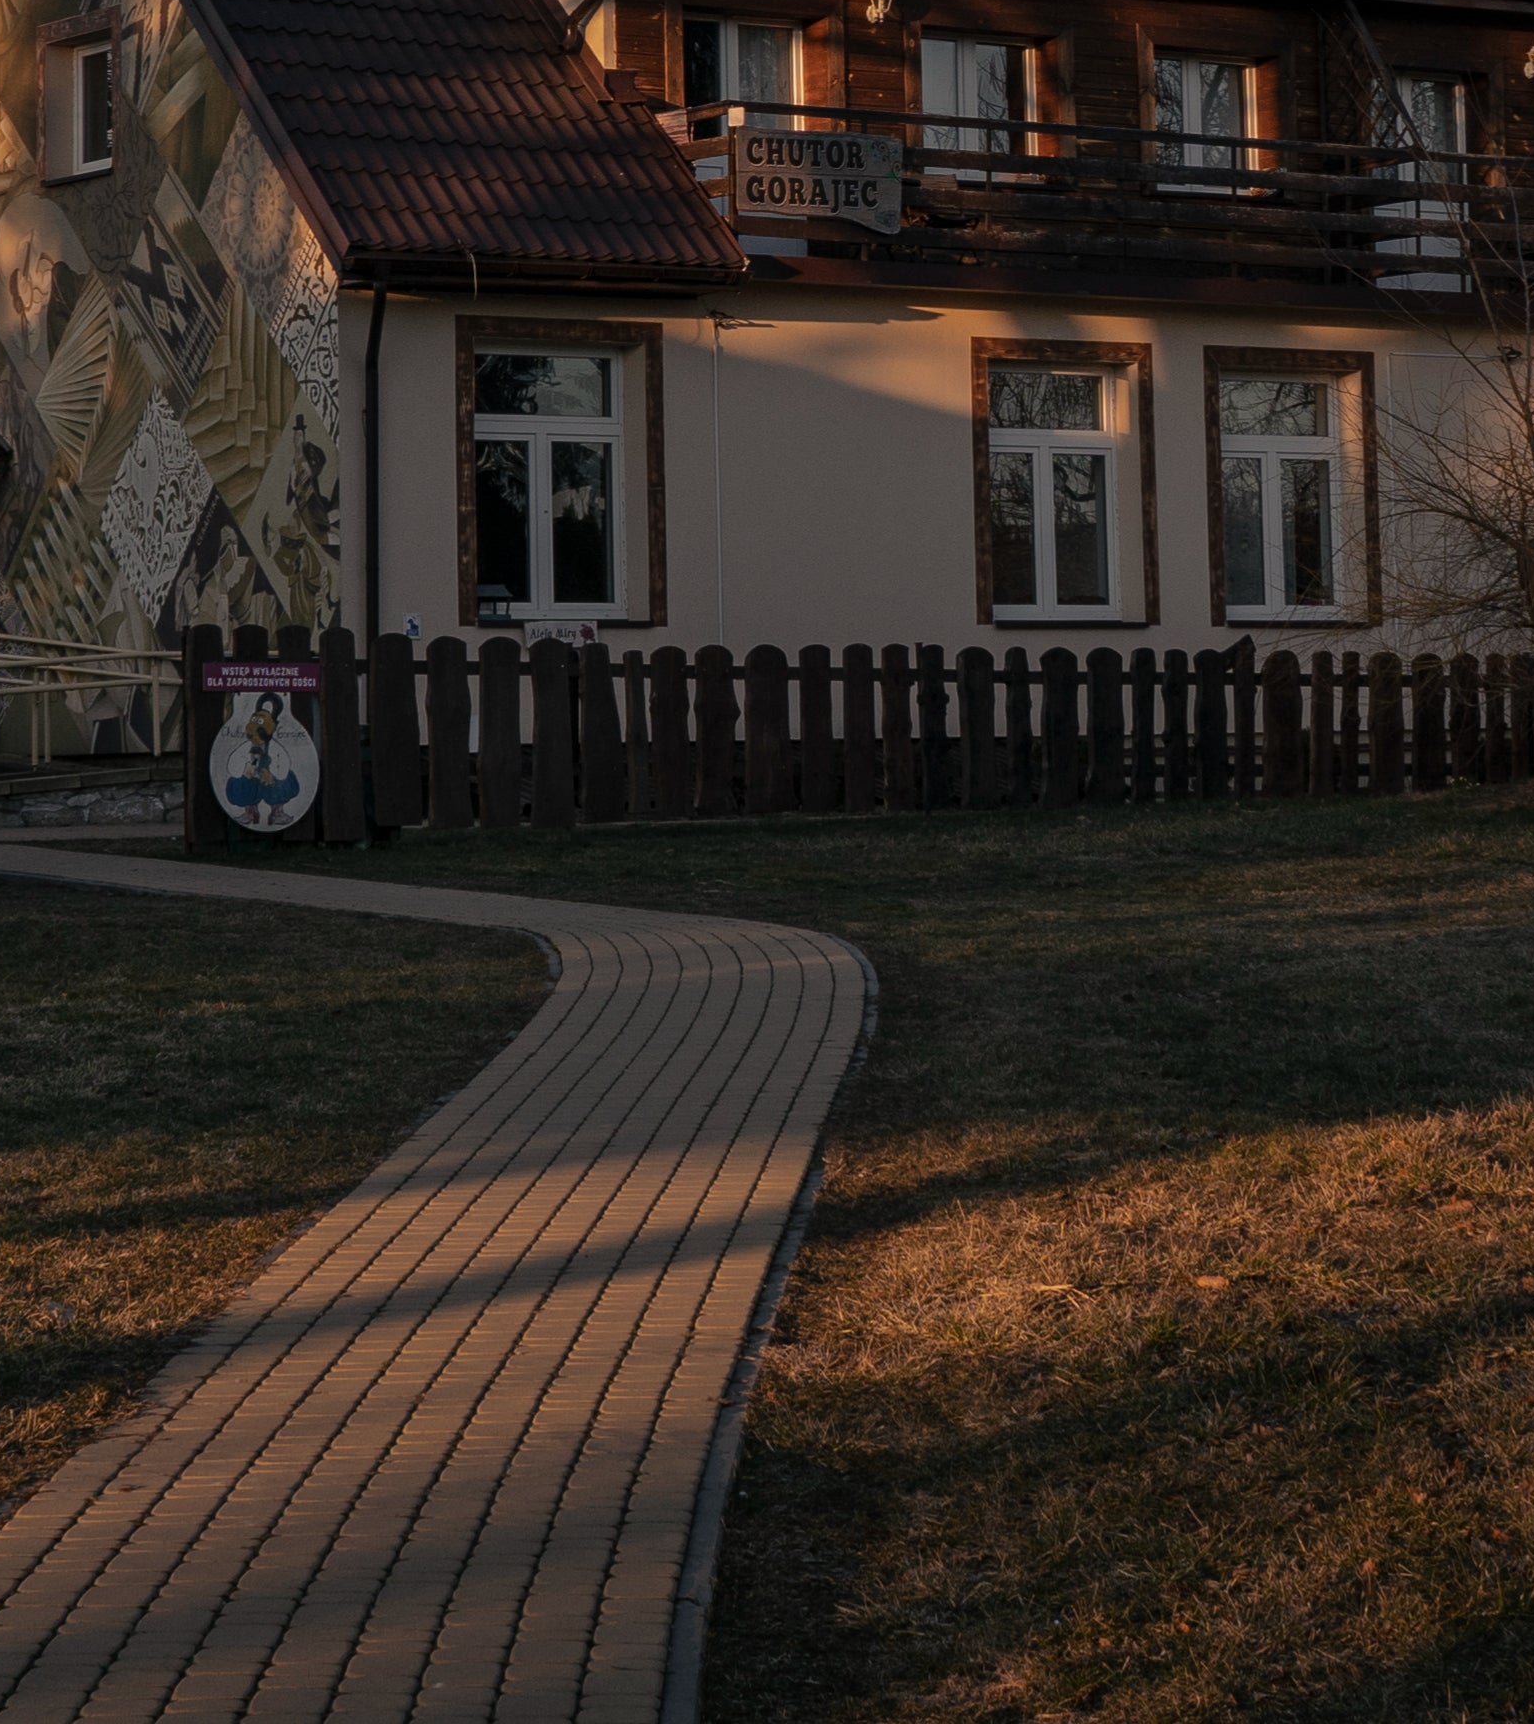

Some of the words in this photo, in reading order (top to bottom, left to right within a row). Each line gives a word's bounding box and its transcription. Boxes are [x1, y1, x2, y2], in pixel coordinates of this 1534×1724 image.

[747, 137, 866, 169] CHUTOR
[746, 175, 879, 214] GORAJEC
[207, 677, 224, 687] DLA
[226, 677, 290, 687] ZAPROSZONYCH
[292, 676, 316, 687] GOŚCI
[221, 666, 250, 677] WSTĘP
[252, 666, 299, 678] WYŁĄCZNIE
